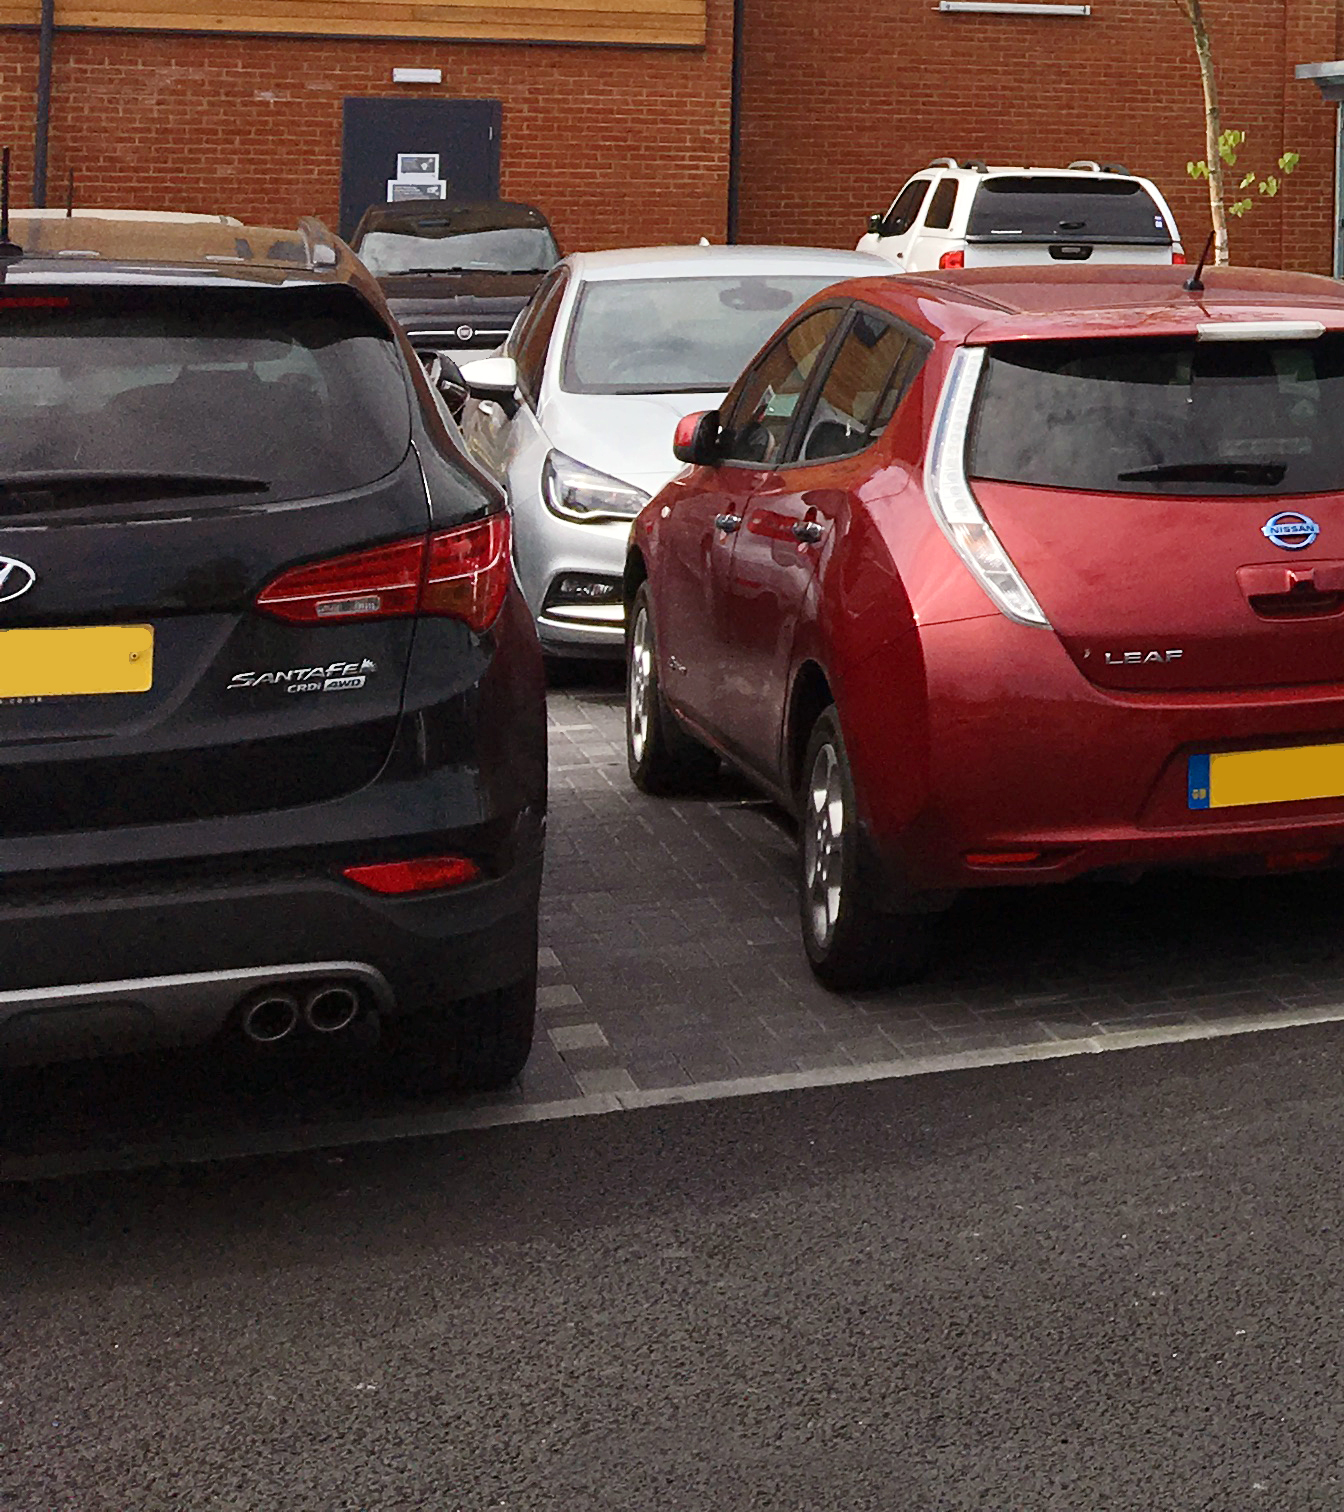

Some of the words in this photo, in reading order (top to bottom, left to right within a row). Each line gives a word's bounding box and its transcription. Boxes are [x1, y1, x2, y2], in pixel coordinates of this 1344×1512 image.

[1270, 525, 1315, 534] NISSAN
[1104, 649, 1184, 665] LEAF
[328, 678, 361, 690] 4WD
